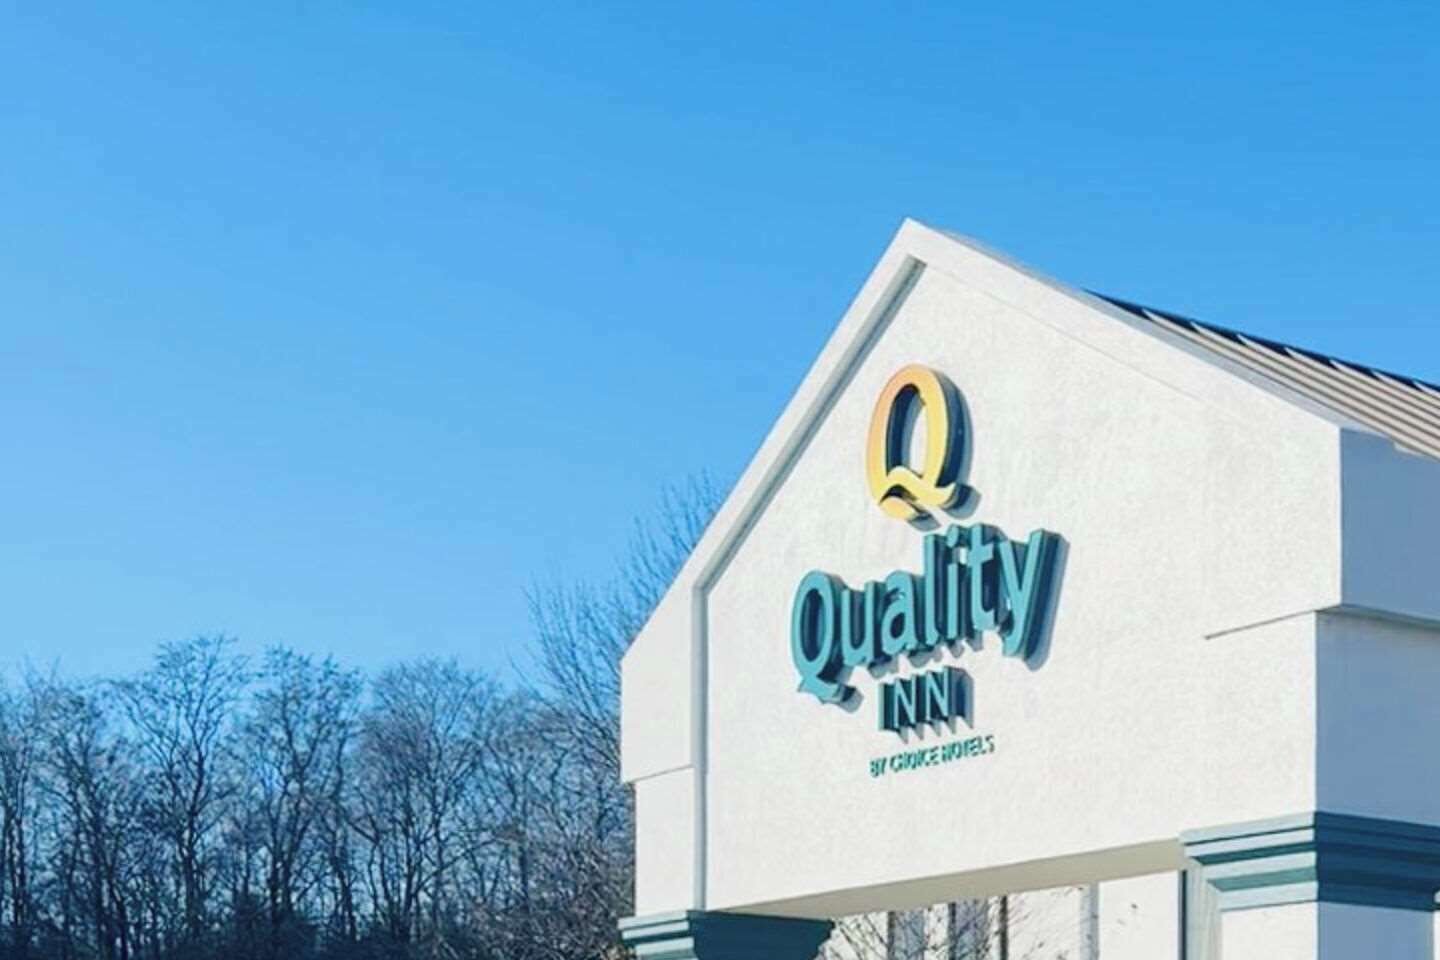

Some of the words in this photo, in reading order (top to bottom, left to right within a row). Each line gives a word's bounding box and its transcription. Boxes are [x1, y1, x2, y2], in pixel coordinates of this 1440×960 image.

[790, 523, 1067, 706] Quality
[879, 667, 973, 735] INN
[870, 758, 887, 778] BY
[889, 746, 939, 773] CHOICE
[941, 735, 995, 762] HOTELS
